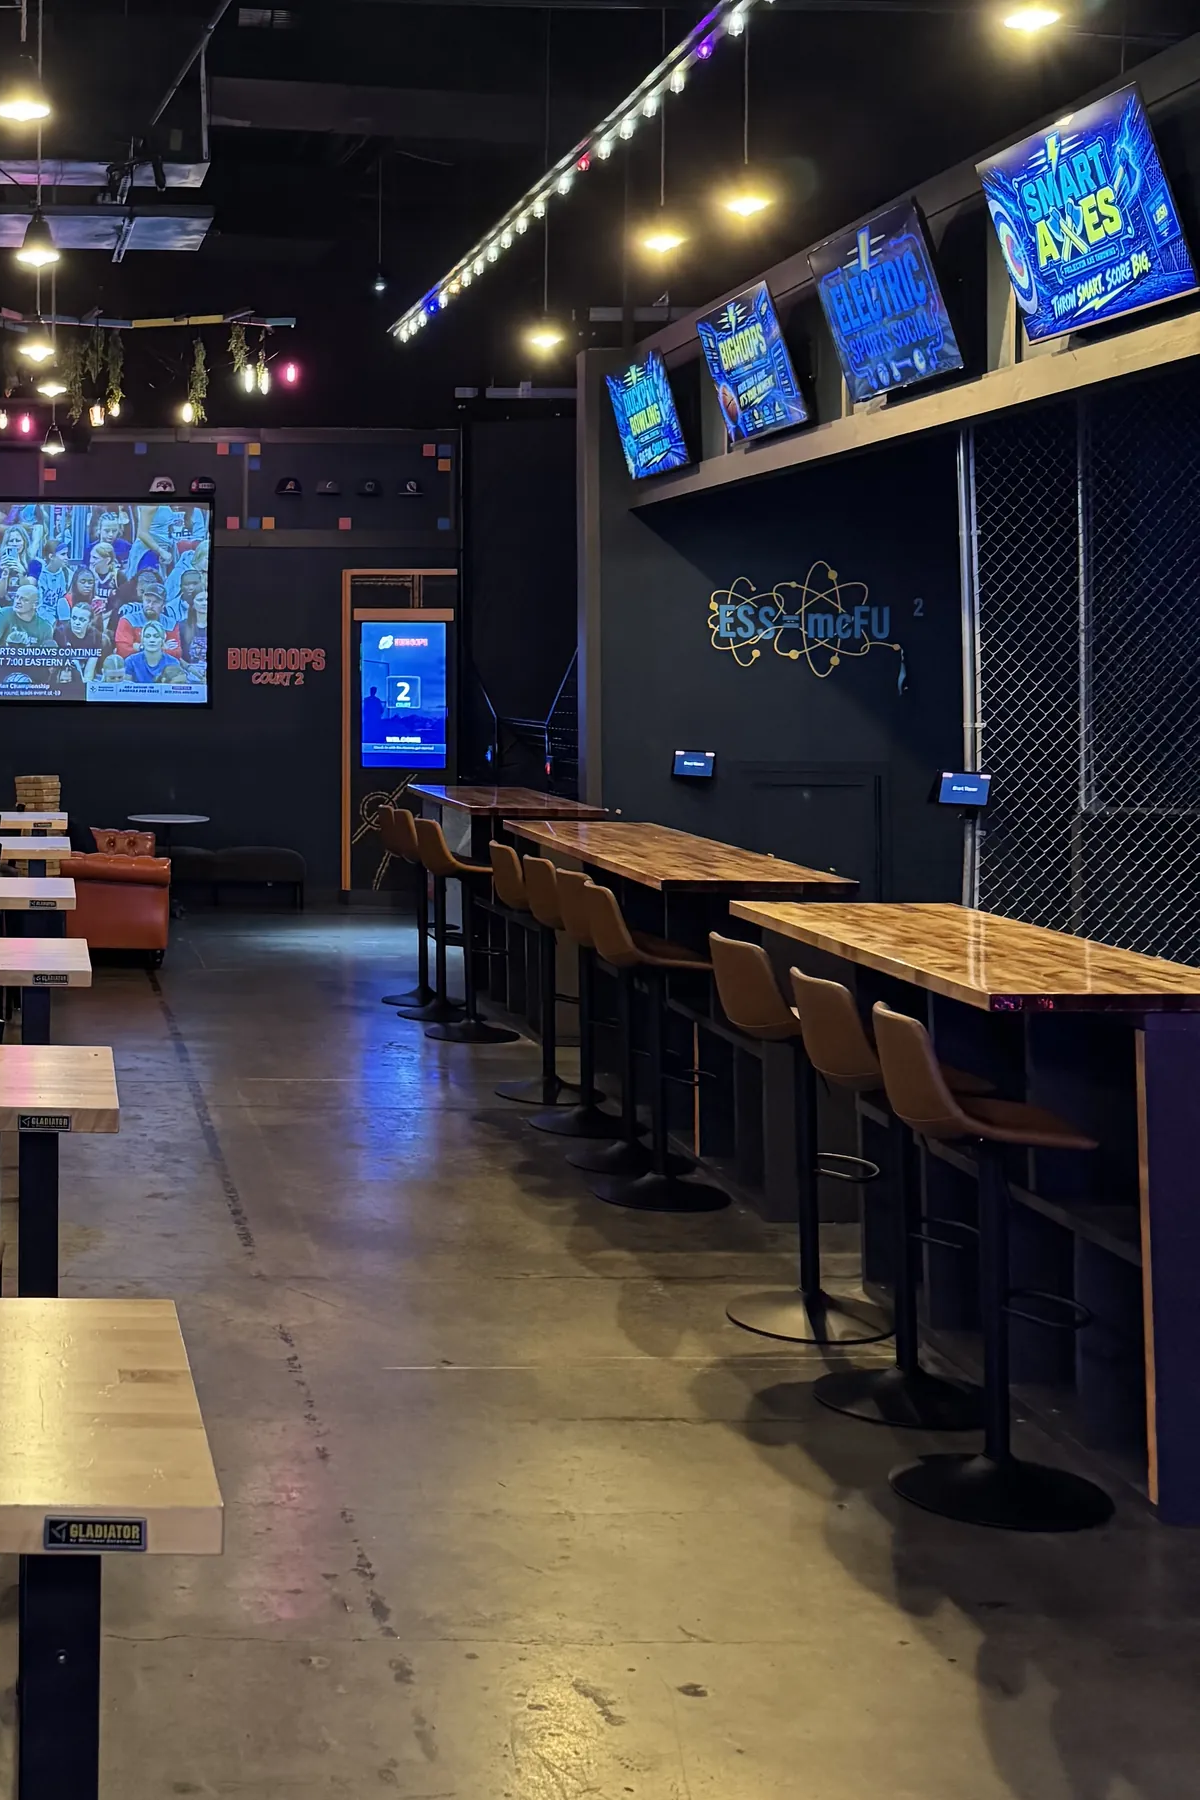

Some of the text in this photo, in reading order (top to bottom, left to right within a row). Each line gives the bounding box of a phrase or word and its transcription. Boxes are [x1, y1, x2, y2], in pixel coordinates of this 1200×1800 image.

[1021, 142, 1108, 221] SMART
[1036, 187, 1122, 267] AXES
[829, 250, 927, 334] ELECTRIC
[1051, 250, 1152, 319] THROW SMART. SCORE BIG.
[718, 322, 767, 371] BIGHOOPS
[850, 311, 937, 364] SPORTS SOCIAL
[629, 402, 660, 437] BOWLING
[6, 658, 23, 666] 7:00
[17, 648, 58, 656] SUNDAYS
[59, 648, 102, 656] CONTINUE
[227, 648, 326, 671] BIGHOOPS
[251, 672, 304, 686] COURT 2
[396, 682, 411, 701] 2
[31, 1116, 68, 1125] GLADIATOR
[69, 1523, 141, 1539] GLADIATOR
